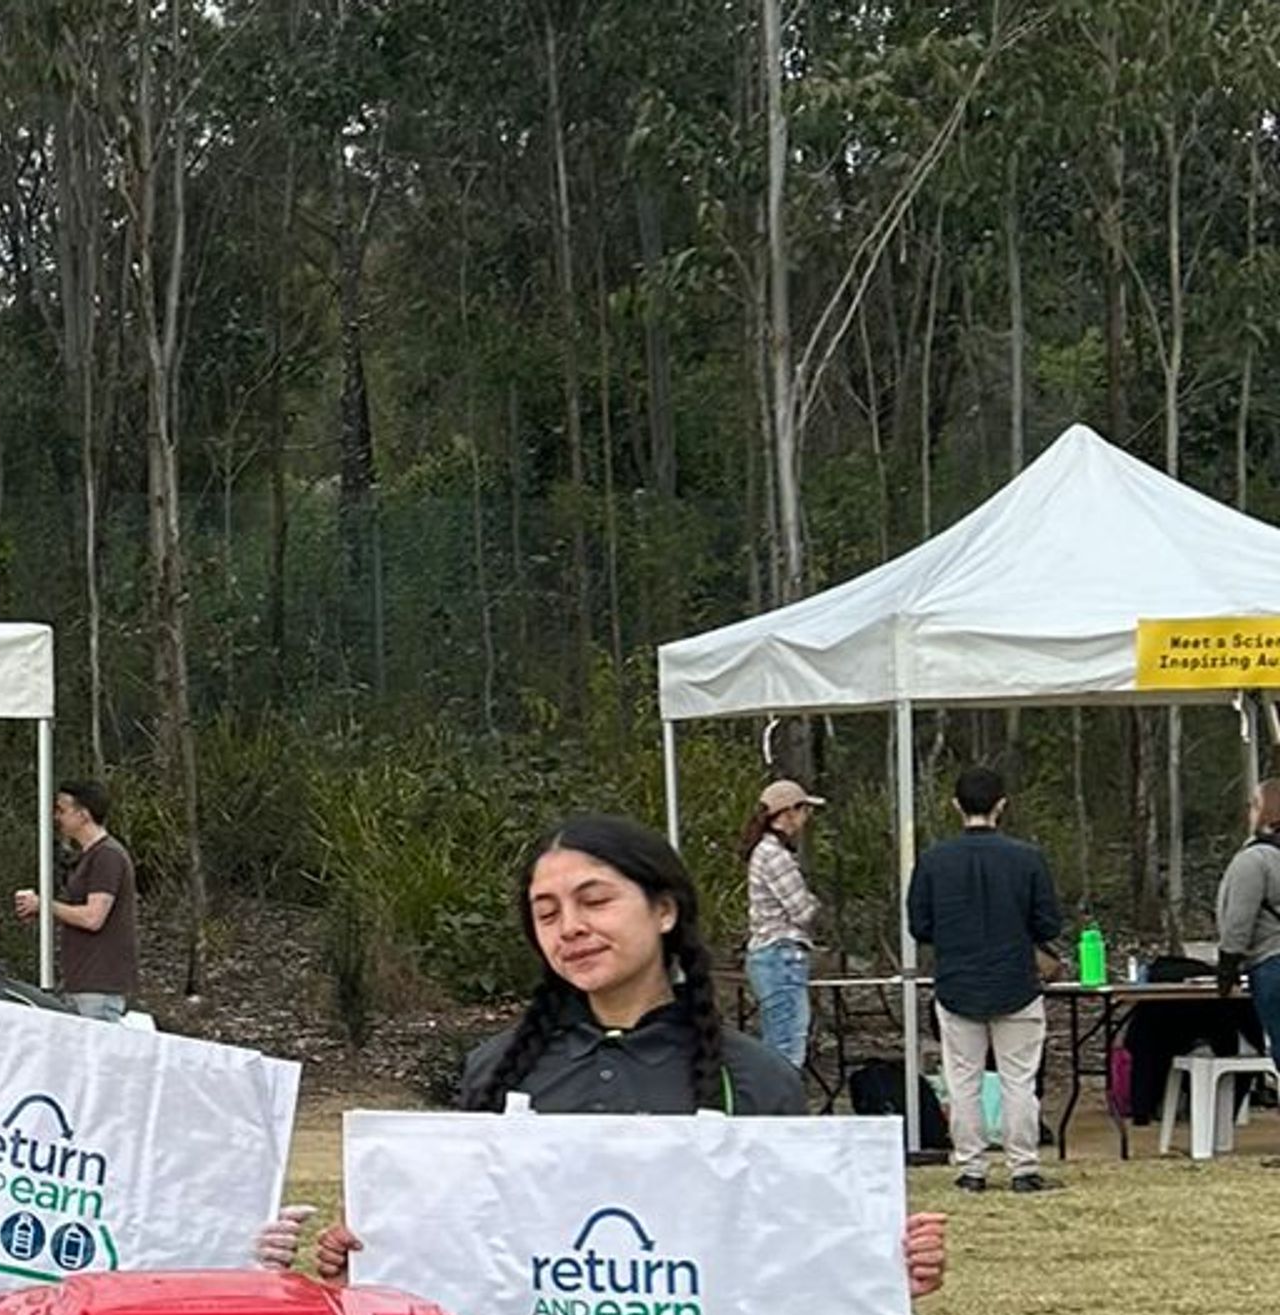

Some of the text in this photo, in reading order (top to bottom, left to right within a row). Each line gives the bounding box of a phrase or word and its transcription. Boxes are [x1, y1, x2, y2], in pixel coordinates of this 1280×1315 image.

[1170, 635, 1210, 649] Meet
[1217, 637, 1226, 649] a
[1160, 653, 1251, 671] Inspiring
[10, 1175, 102, 1219] earn
[532, 1250, 699, 1295] return
